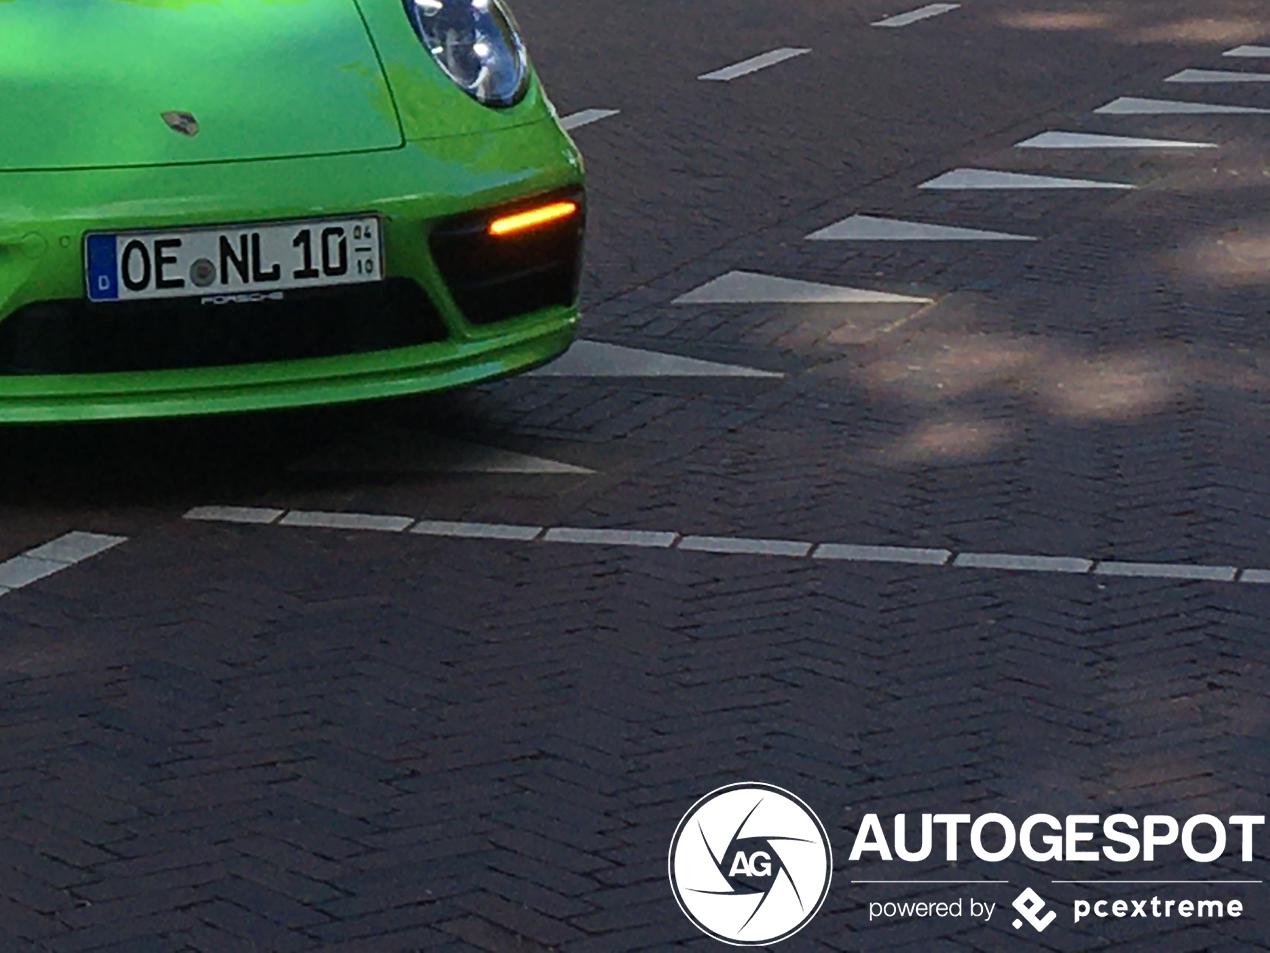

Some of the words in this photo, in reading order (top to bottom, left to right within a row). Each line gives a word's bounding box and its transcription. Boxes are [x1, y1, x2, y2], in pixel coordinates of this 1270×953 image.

[121, 238, 185, 291] OE
[218, 233, 281, 284] NL
[292, 226, 348, 280] 10
[357, 258, 374, 274] 10
[97, 275, 110, 290] D
